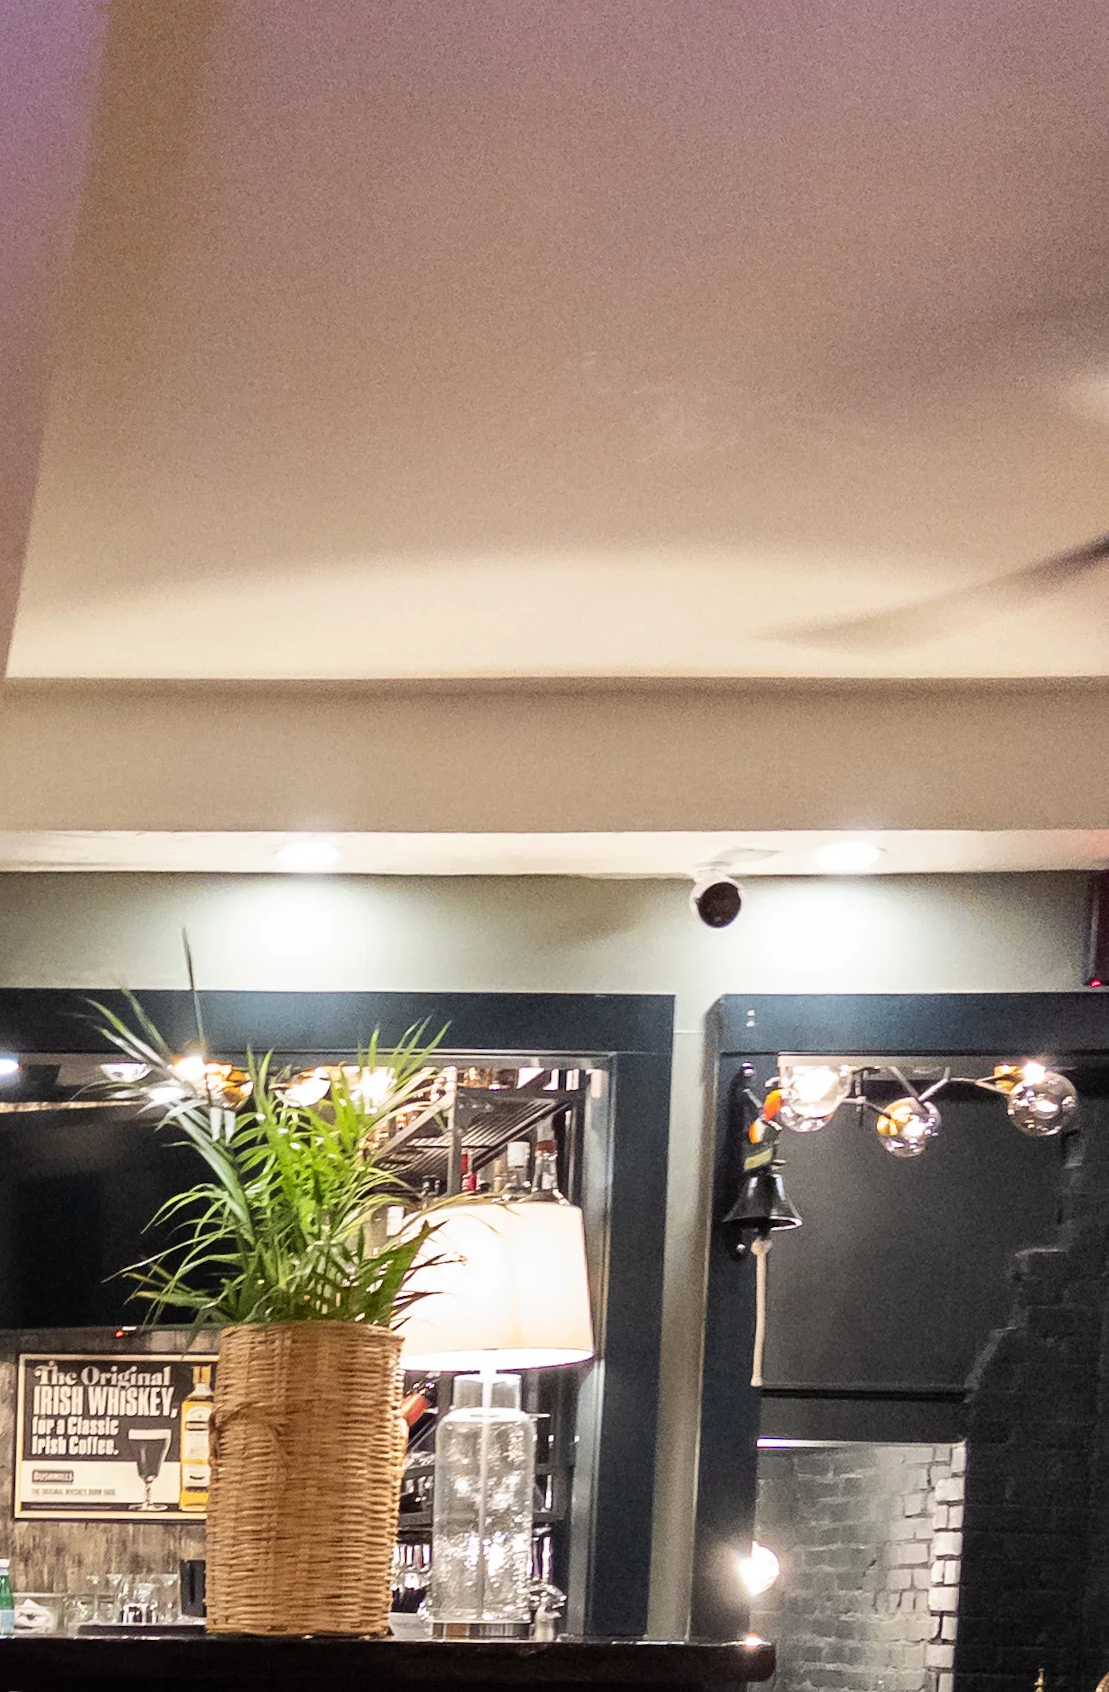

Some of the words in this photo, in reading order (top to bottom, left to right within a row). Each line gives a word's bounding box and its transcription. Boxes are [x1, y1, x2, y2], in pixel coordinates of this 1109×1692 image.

[34, 1360, 78, 1385] The
[80, 1365, 171, 1389] Original
[32, 1385, 83, 1416] IRISH
[32, 1415, 52, 1436] for
[55, 1419, 65, 1436] a
[67, 1416, 120, 1436] Classic
[31, 1435, 66, 1456] Irish
[68, 1435, 120, 1456] Coffee.
